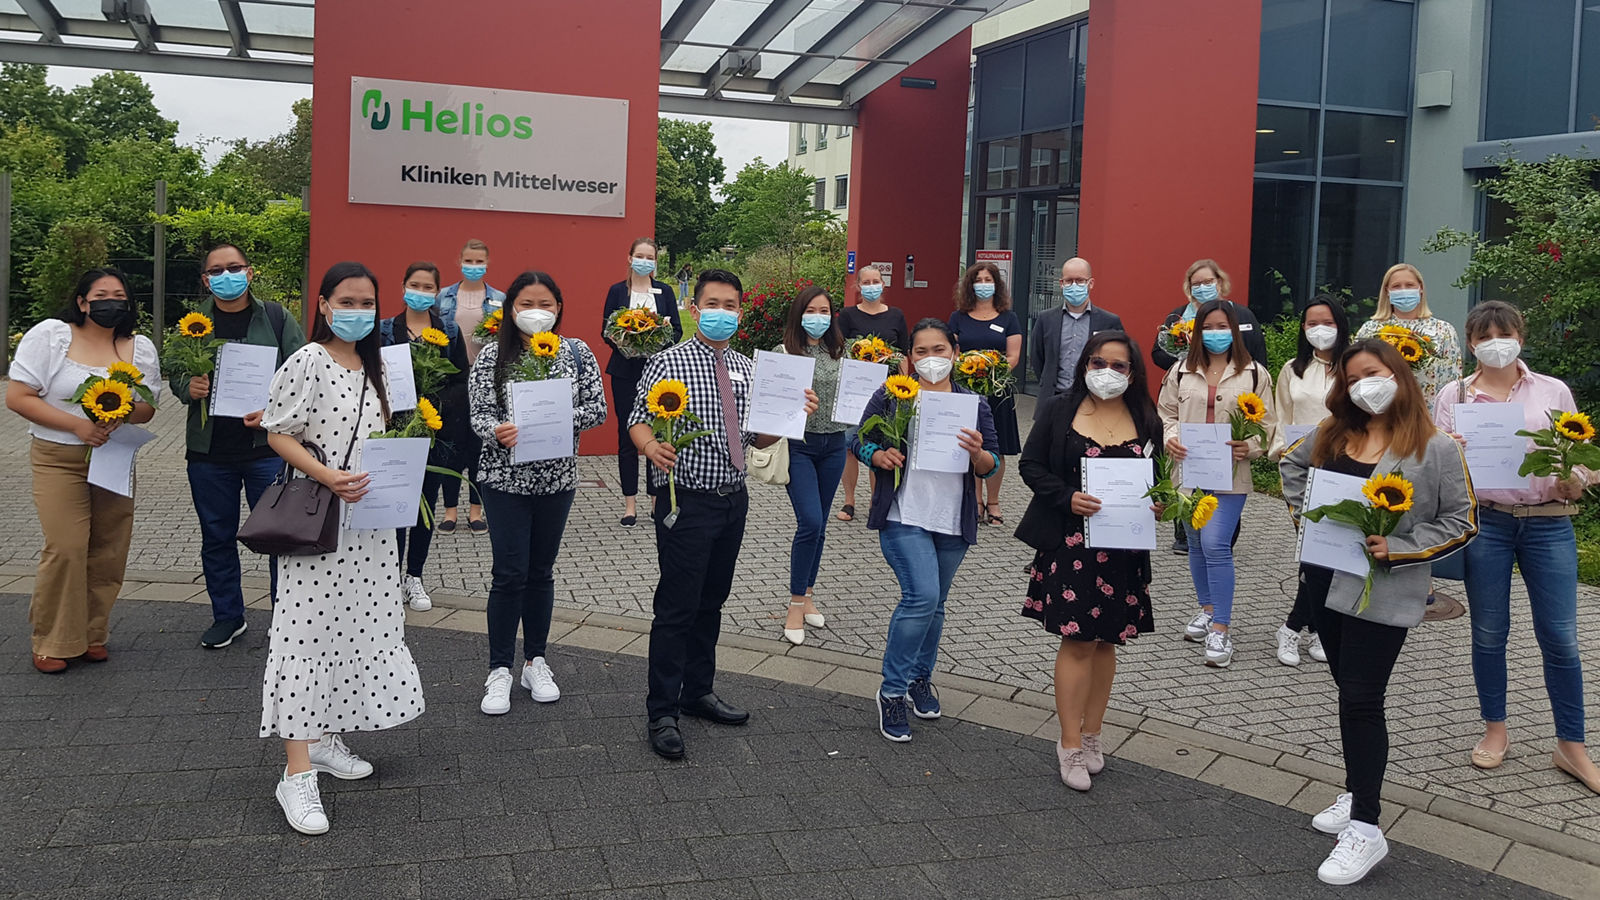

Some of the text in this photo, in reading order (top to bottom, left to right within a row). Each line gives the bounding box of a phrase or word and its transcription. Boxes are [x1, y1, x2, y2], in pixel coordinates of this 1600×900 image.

[402, 98, 533, 140] Helios
[401, 164, 618, 195] Kliniken Mittelweser
